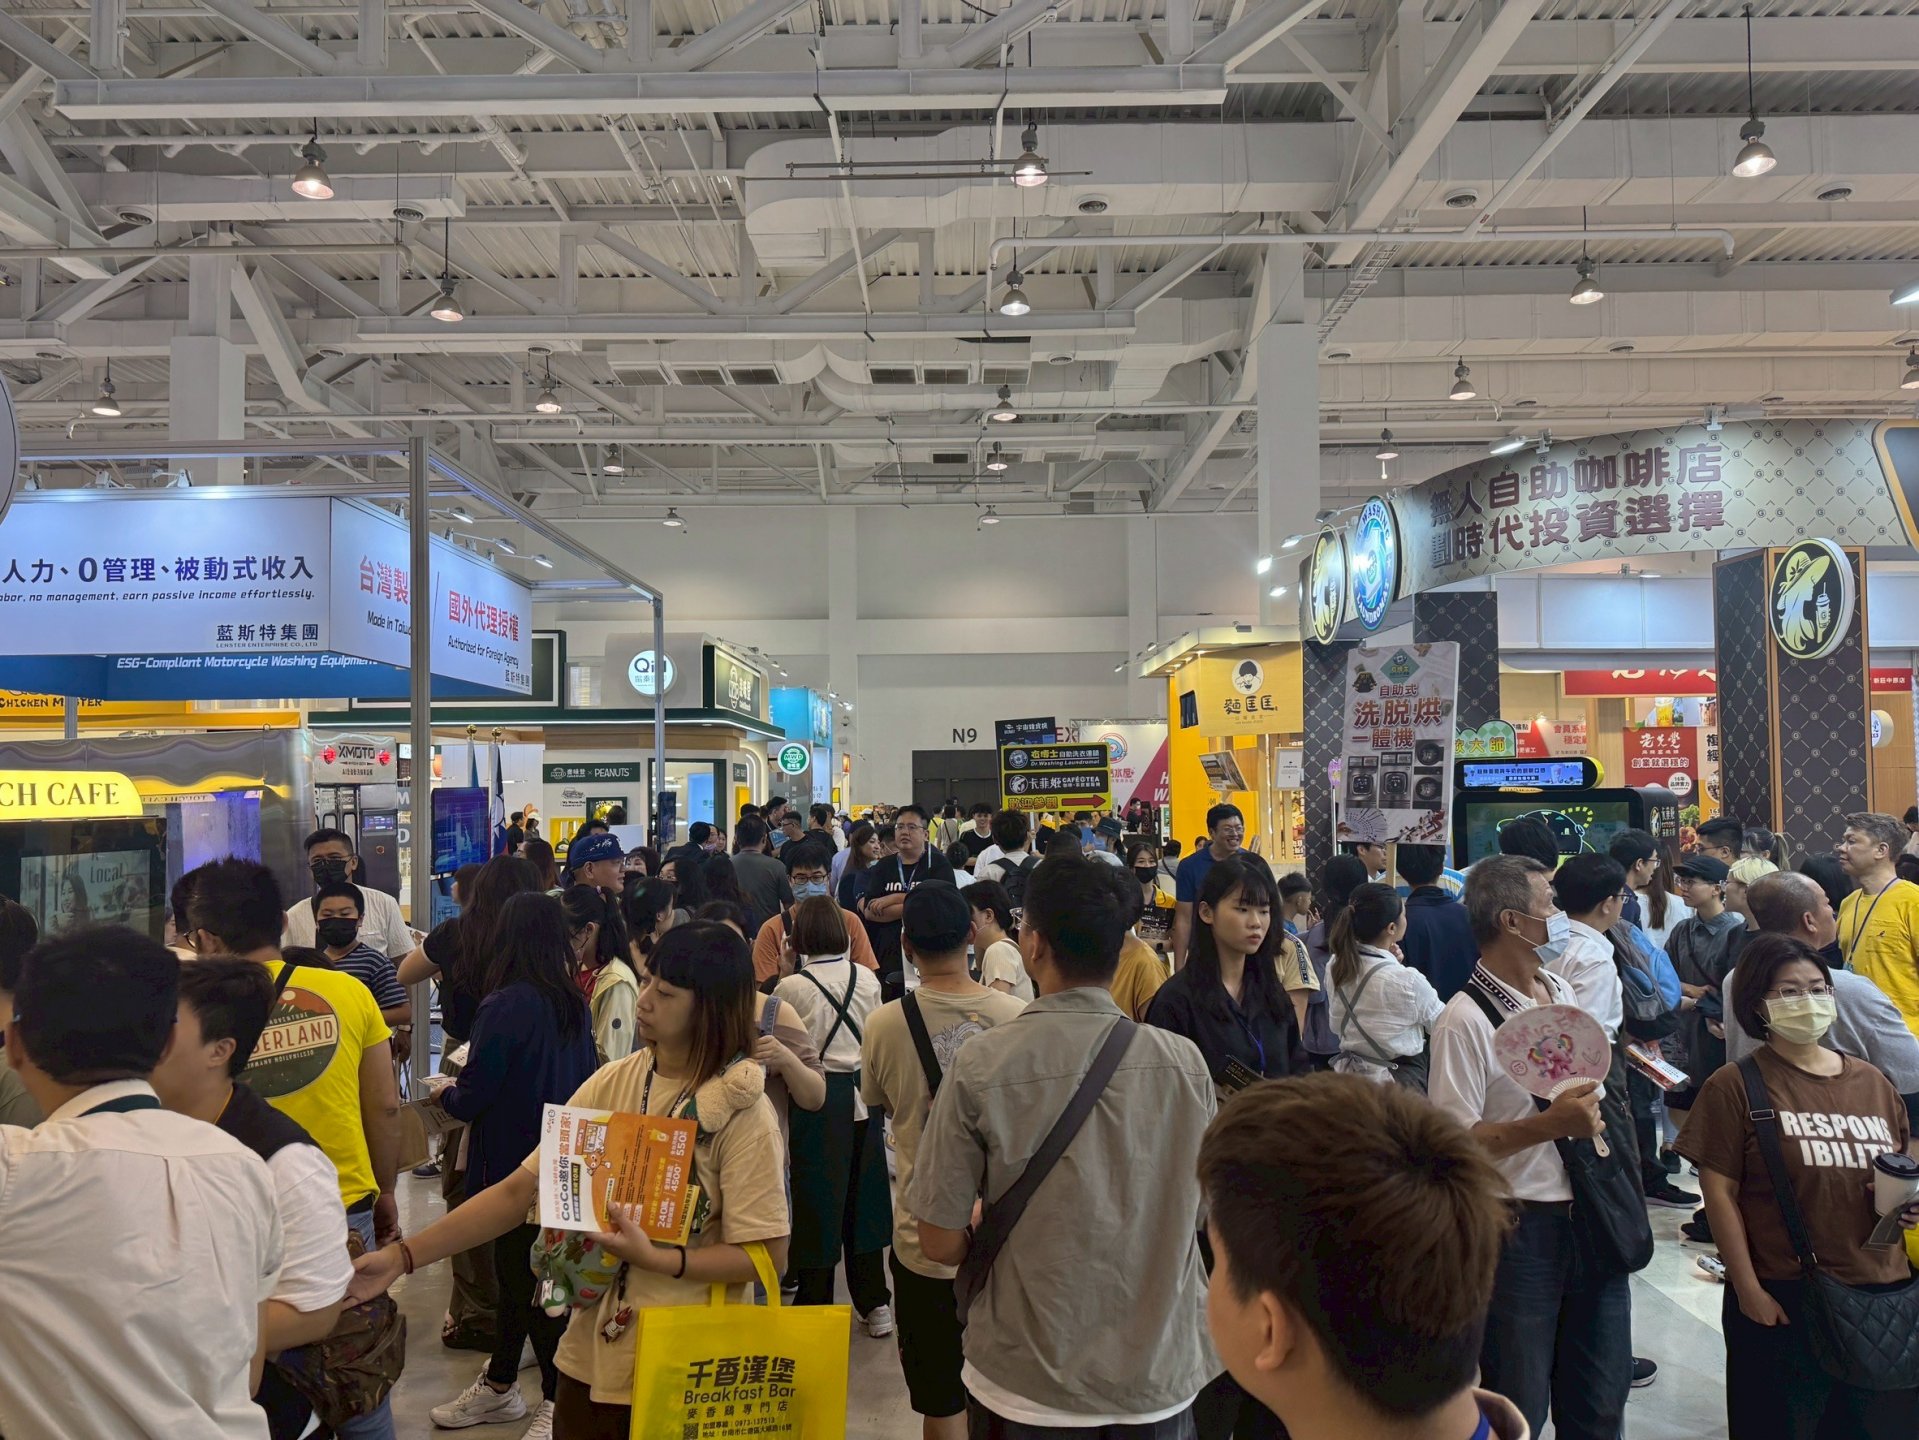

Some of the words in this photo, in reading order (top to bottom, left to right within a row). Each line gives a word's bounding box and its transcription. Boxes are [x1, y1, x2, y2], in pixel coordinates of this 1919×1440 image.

[1430, 443, 1723, 527] 無人自助咖啡店
[359, 555, 411, 605] 台灣製
[29, 594, 43, 602] no
[123, 592, 149, 600] earn
[152, 591, 195, 602] passive
[199, 589, 237, 599] income
[367, 610, 385, 628] Made
[386, 616, 394, 630] in
[448, 590, 519, 642] 國外代理授權
[216, 623, 319, 641] 藍斯特集團
[117, 657, 201, 670] ESG-Compliant
[204, 655, 268, 670] Motorcycle
[271, 655, 317, 669] Washing
[448, 635, 476, 658] Authorized
[477, 645, 485, 658] for
[485, 646, 504, 664] Foreign
[504, 650, 519, 669] Agency
[1380, 684, 1418, 697] 自助式
[1223, 694, 1275, 715] 麵匡匡
[1353, 697, 1442, 727] 洗脫烘
[952, 728, 978, 744] N9
[1351, 727, 1415, 748] 一體機
[338, 745, 376, 760] XMOTO
[595, 767, 630, 777] PEANUTS
[47, 782, 119, 807] CAFE
[1779, 1110, 1893, 1145] RESPONS
[687, 1354, 796, 1389] 千香漢堡
[769, 1383, 796, 1397] Bar
